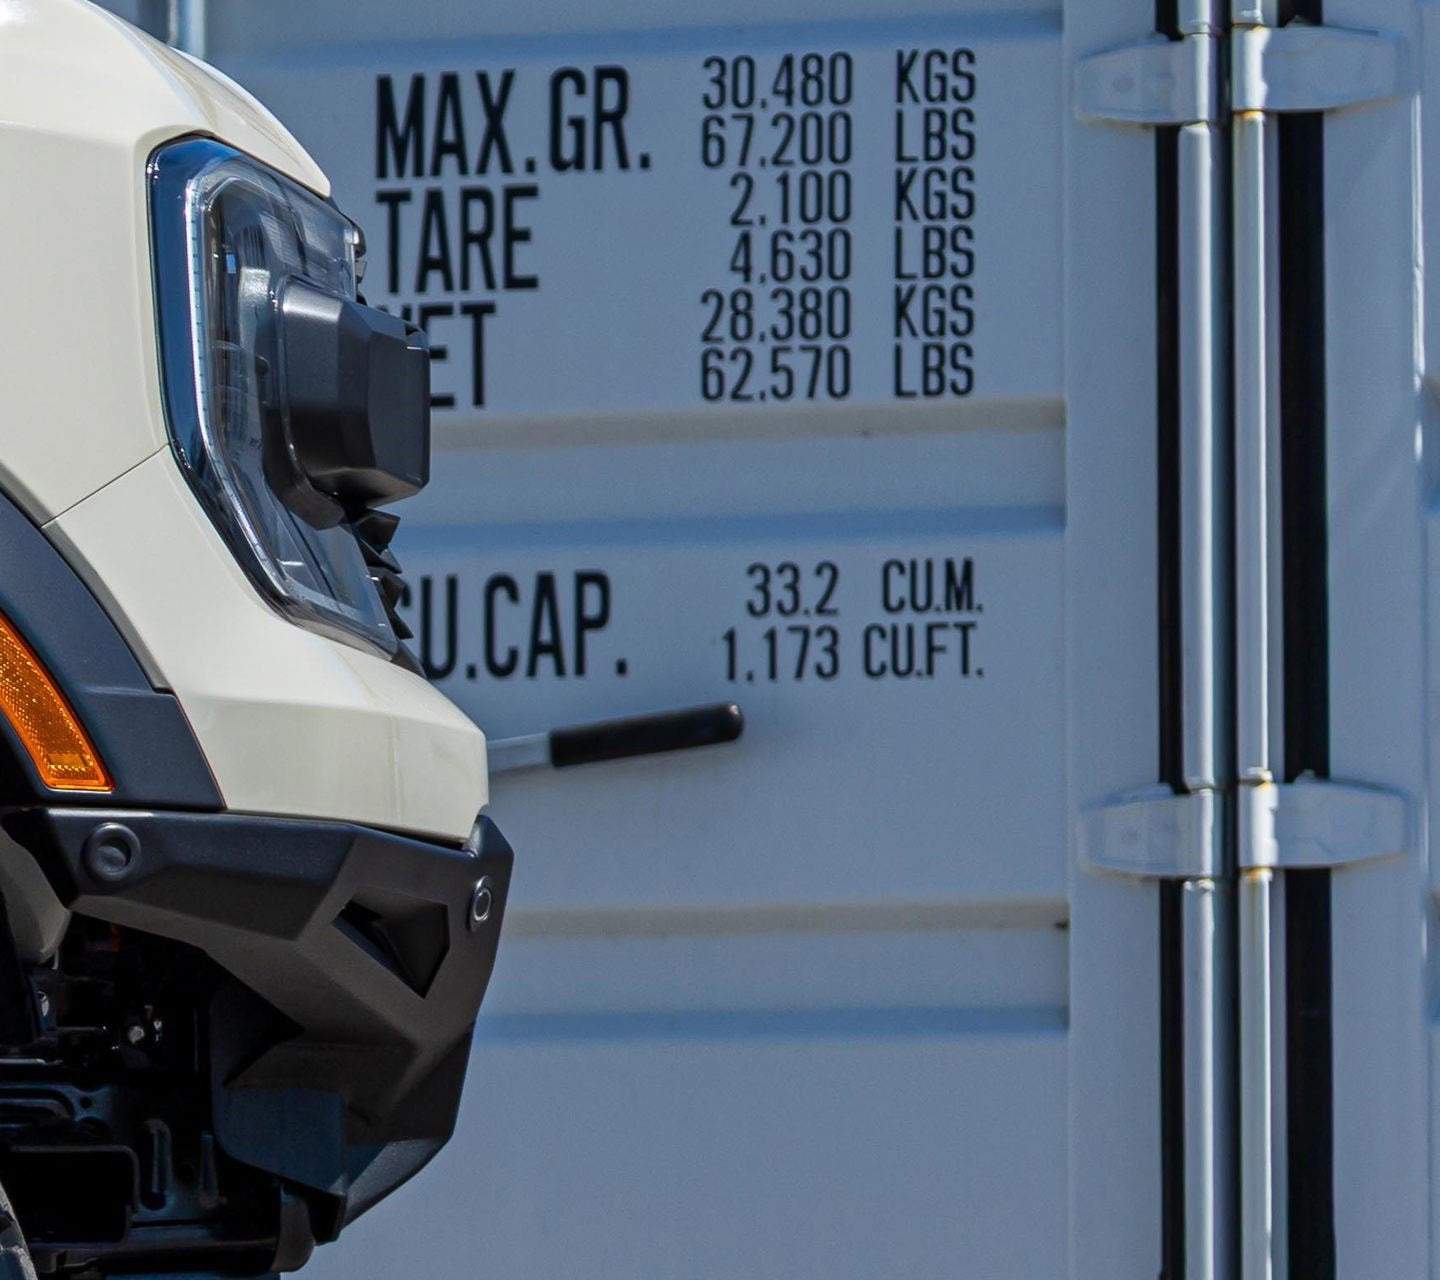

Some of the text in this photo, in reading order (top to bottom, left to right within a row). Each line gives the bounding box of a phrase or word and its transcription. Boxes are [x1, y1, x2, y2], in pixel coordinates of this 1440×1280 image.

[702, 48, 977, 111] 30.480 KGS
[375, 65, 651, 181] MAX.GR.
[700, 107, 976, 169] 67.200 LBS
[729, 166, 976, 228] 2.100 KGS
[374, 184, 540, 295] TARE
[729, 224, 976, 284] 4.630 LBS
[700, 283, 975, 344] 28.380 KGS
[380, 300, 496, 408] ET
[700, 341, 975, 402] 62.570 LBS
[745, 557, 984, 619] 33.2 CU.M.
[399, 570, 628, 681] U.CAP.
[722, 621, 984, 683] 1.173 CU.FT.
